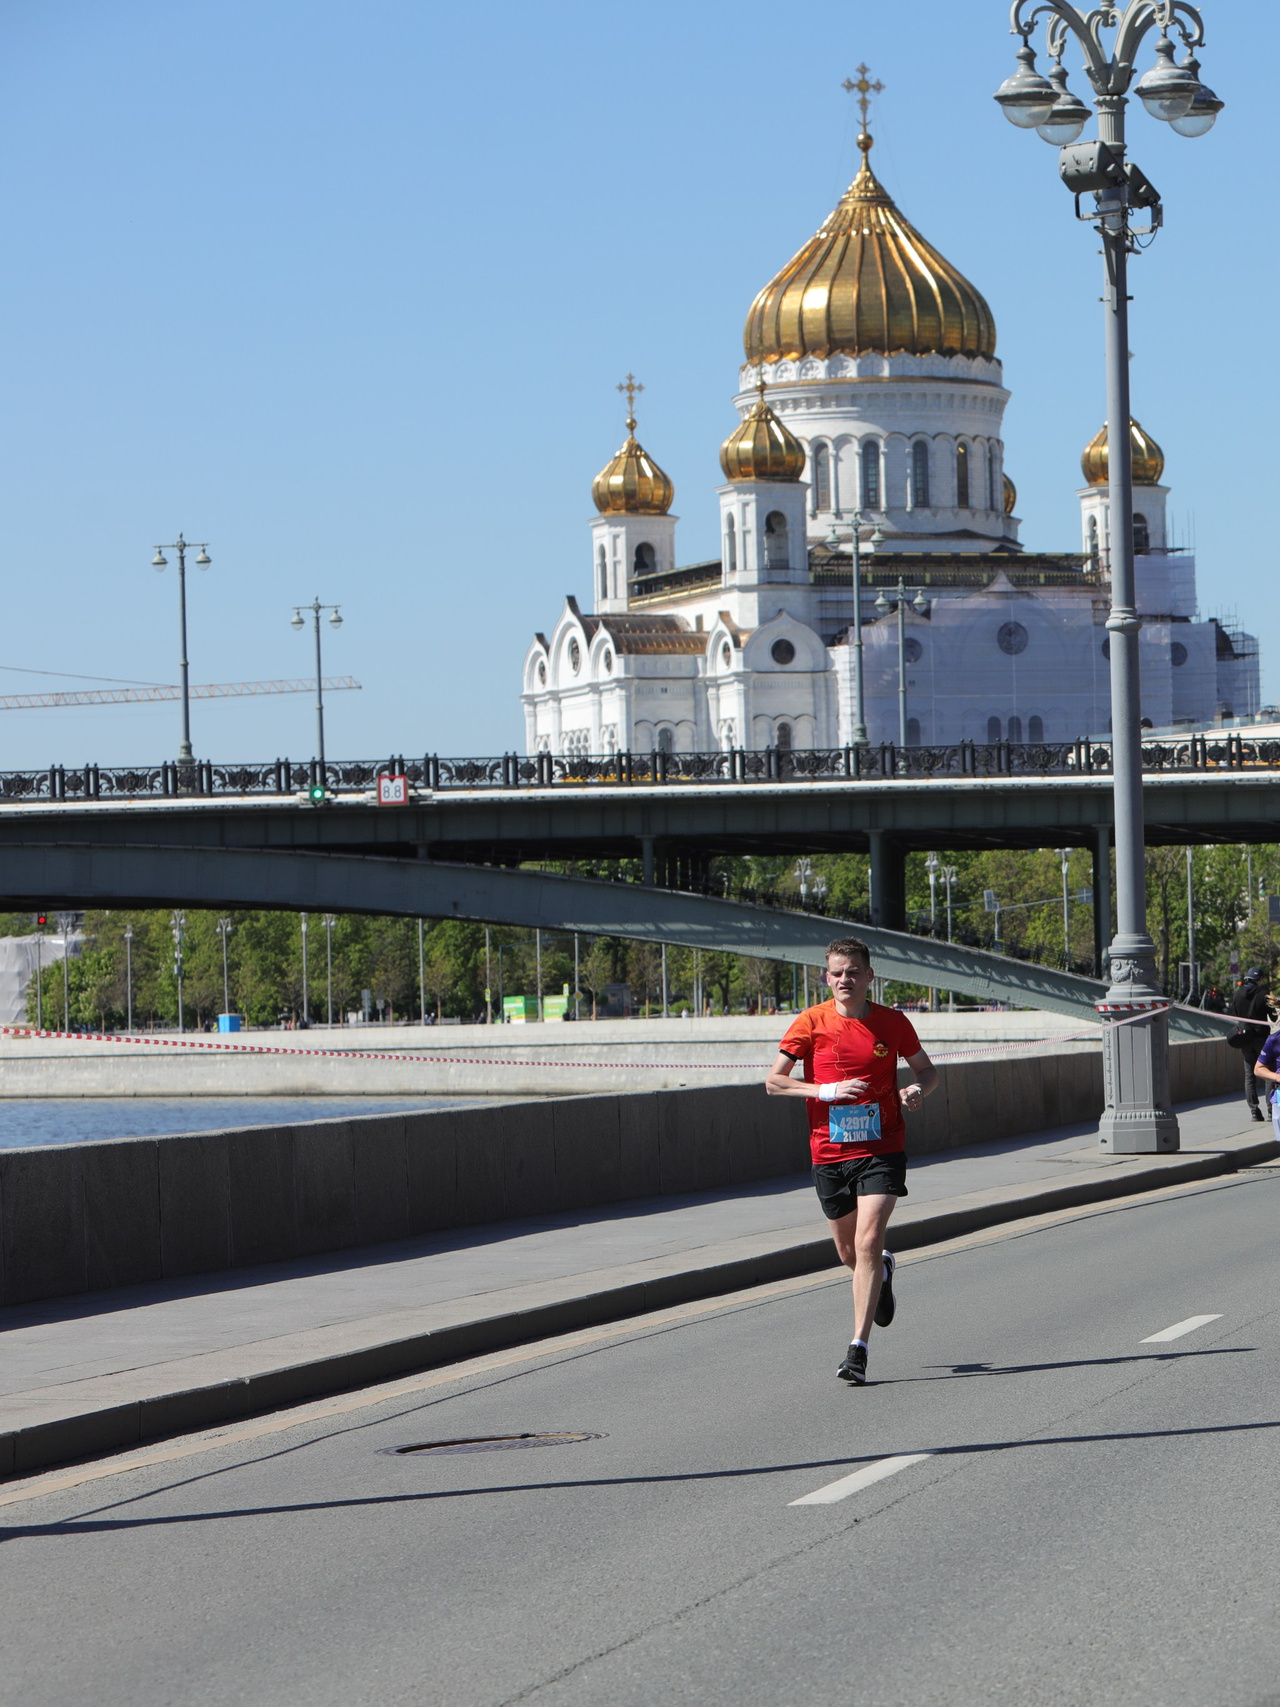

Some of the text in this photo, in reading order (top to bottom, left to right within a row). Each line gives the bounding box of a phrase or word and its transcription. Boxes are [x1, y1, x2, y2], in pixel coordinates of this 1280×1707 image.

[383, 785, 401, 799] 8.8
[840, 1116, 869, 1130] 42917
[843, 1131, 868, 1142] 21.1KM
